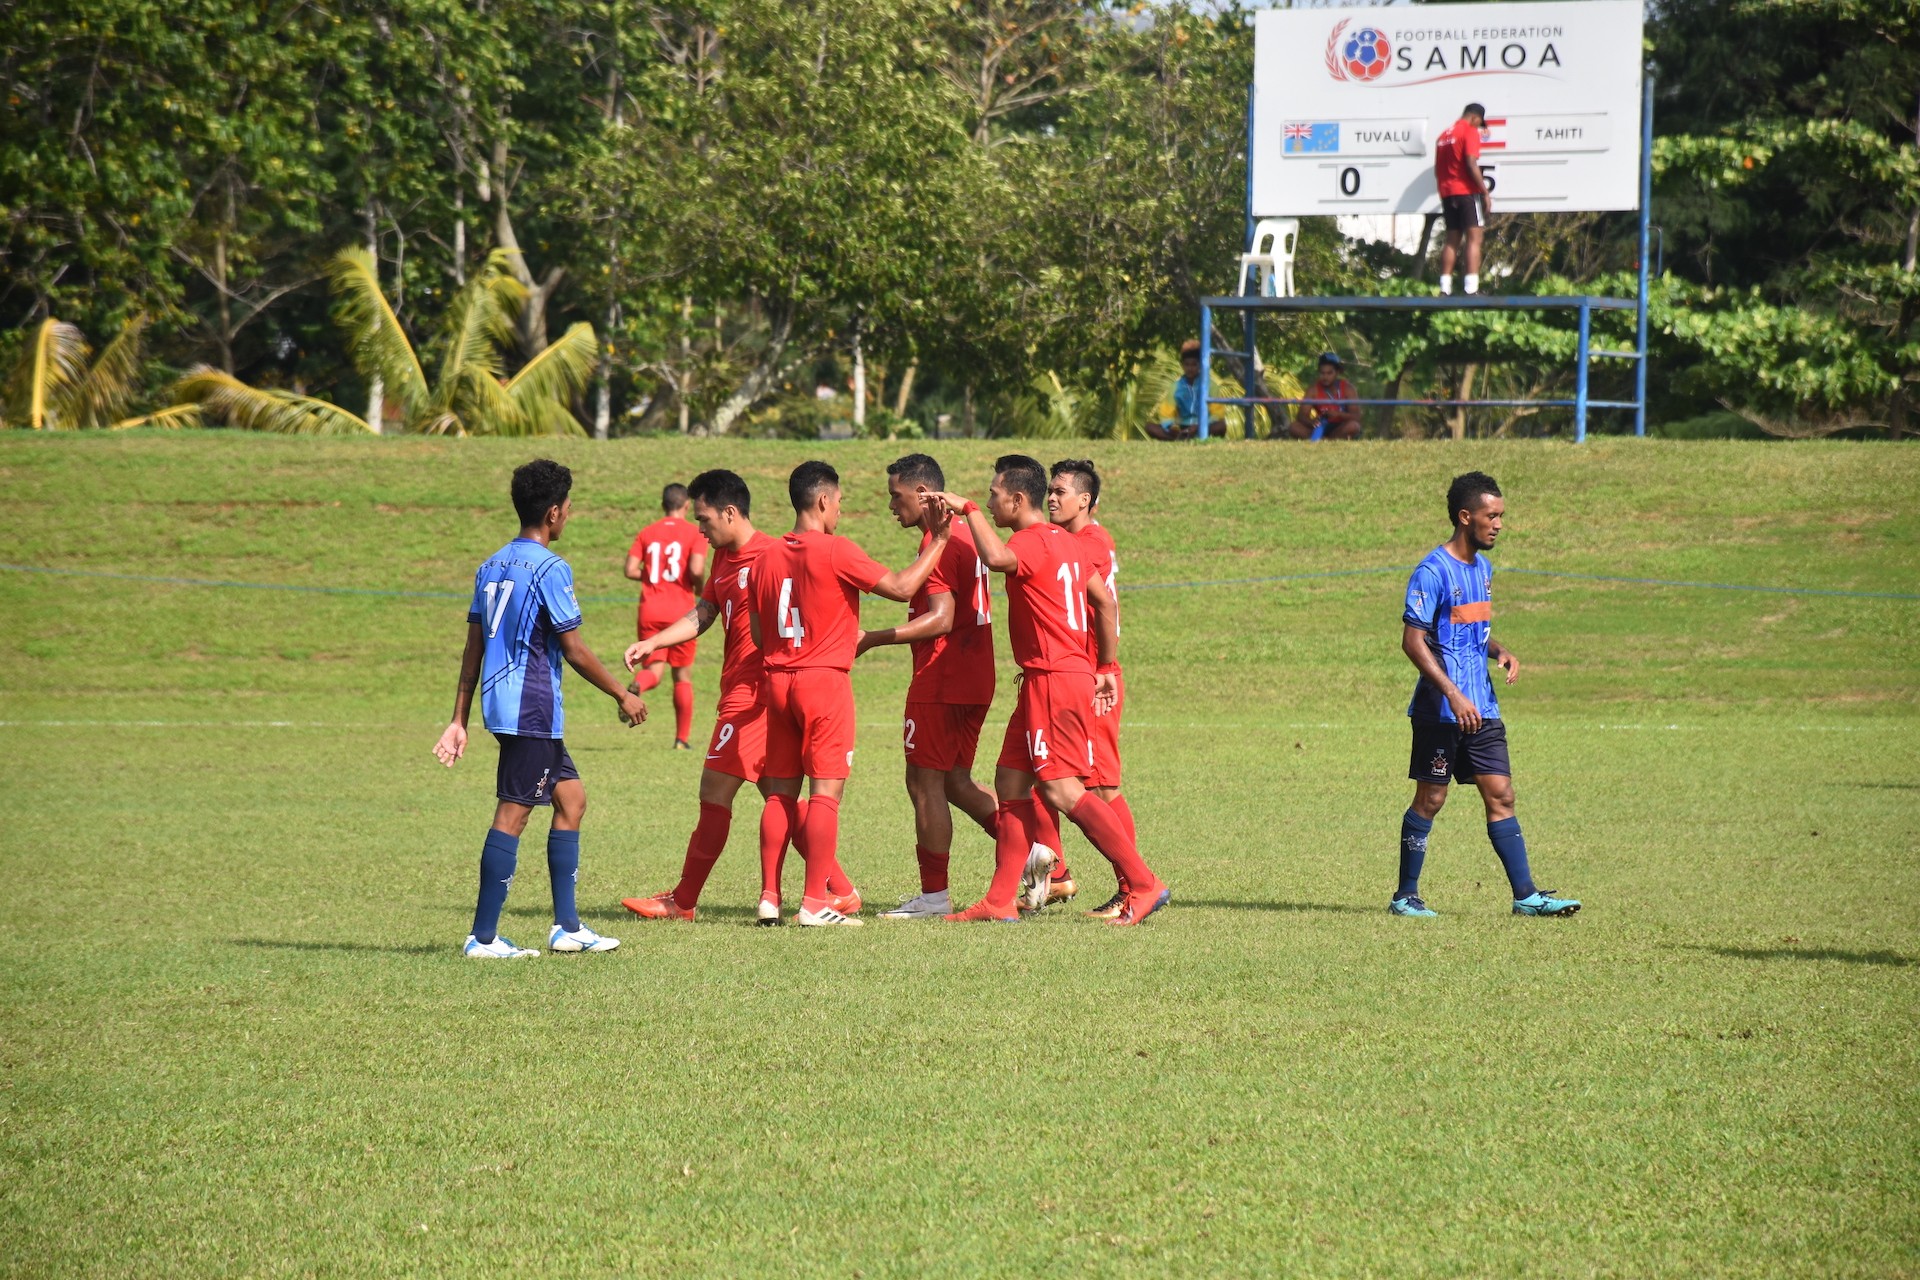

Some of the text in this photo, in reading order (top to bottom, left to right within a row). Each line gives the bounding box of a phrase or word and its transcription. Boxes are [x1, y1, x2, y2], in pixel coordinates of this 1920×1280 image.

[1395, 26, 1563, 42] FOOTBALL FEDERATION
[1396, 43, 1562, 71] SAMOA
[1354, 131, 1411, 143] TUVALU
[1535, 128, 1583, 140] TAHITI
[1340, 167, 1361, 197] 0
[1479, 165, 1496, 194] 5
[647, 541, 681, 584] 13
[484, 579, 515, 638] 17
[726, 599, 732, 630] 9
[778, 578, 805, 648] 4
[714, 723, 734, 751] 9
[903, 718, 916, 750] 2
[1026, 729, 1049, 760] 14
